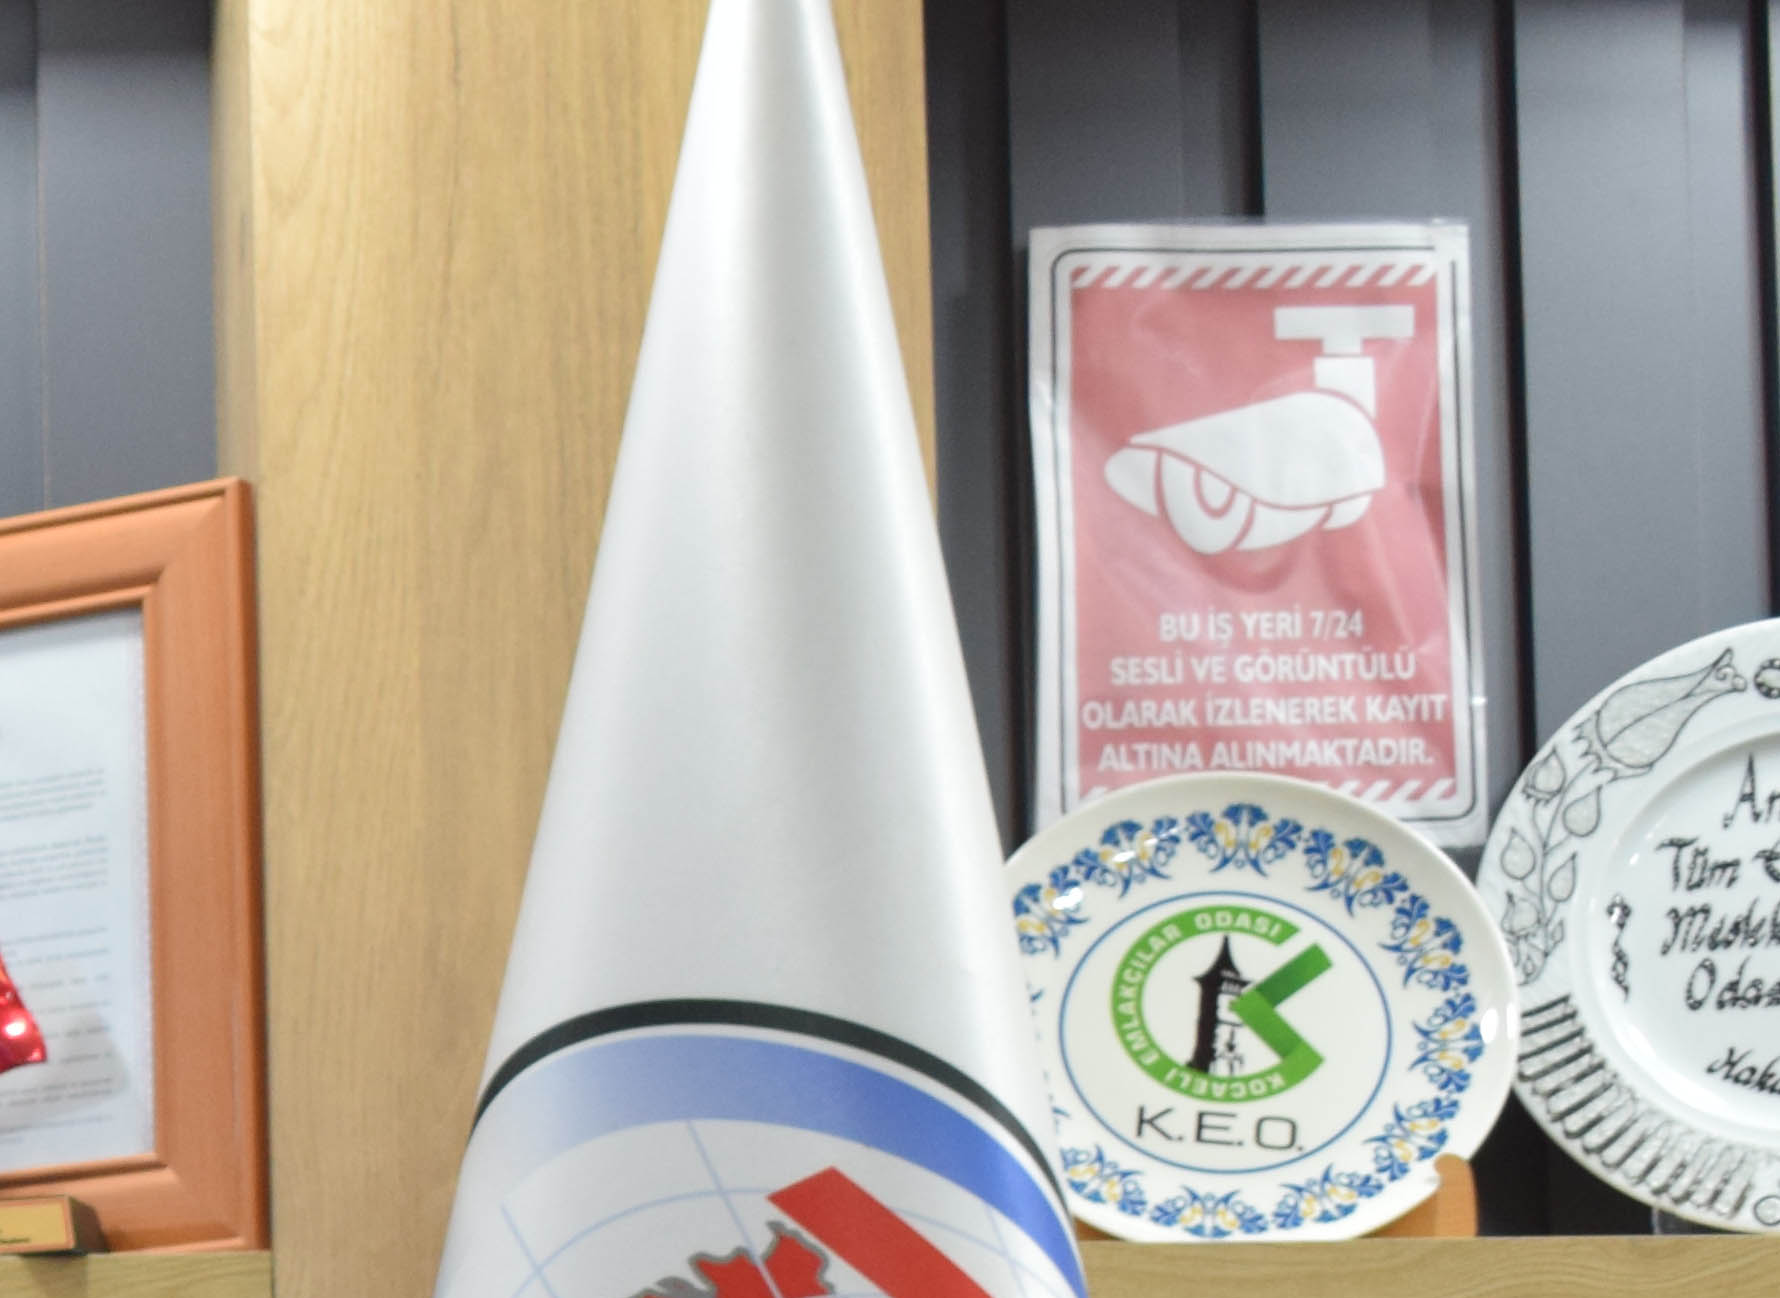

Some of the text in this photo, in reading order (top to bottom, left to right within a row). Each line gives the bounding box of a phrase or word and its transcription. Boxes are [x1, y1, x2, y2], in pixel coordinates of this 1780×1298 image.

[1158, 605, 1364, 648] BU İŞ YERİ 7/24
[1109, 645, 1417, 686] SESLİ VE GÖRÜNTÜLÜ
[1081, 690, 1448, 730] OLARAK İZLENEREK KAYIT
[1096, 736, 1435, 773] ALTINA ALINMAKTADIR.
[1194, 910, 1283, 938] ODASI
